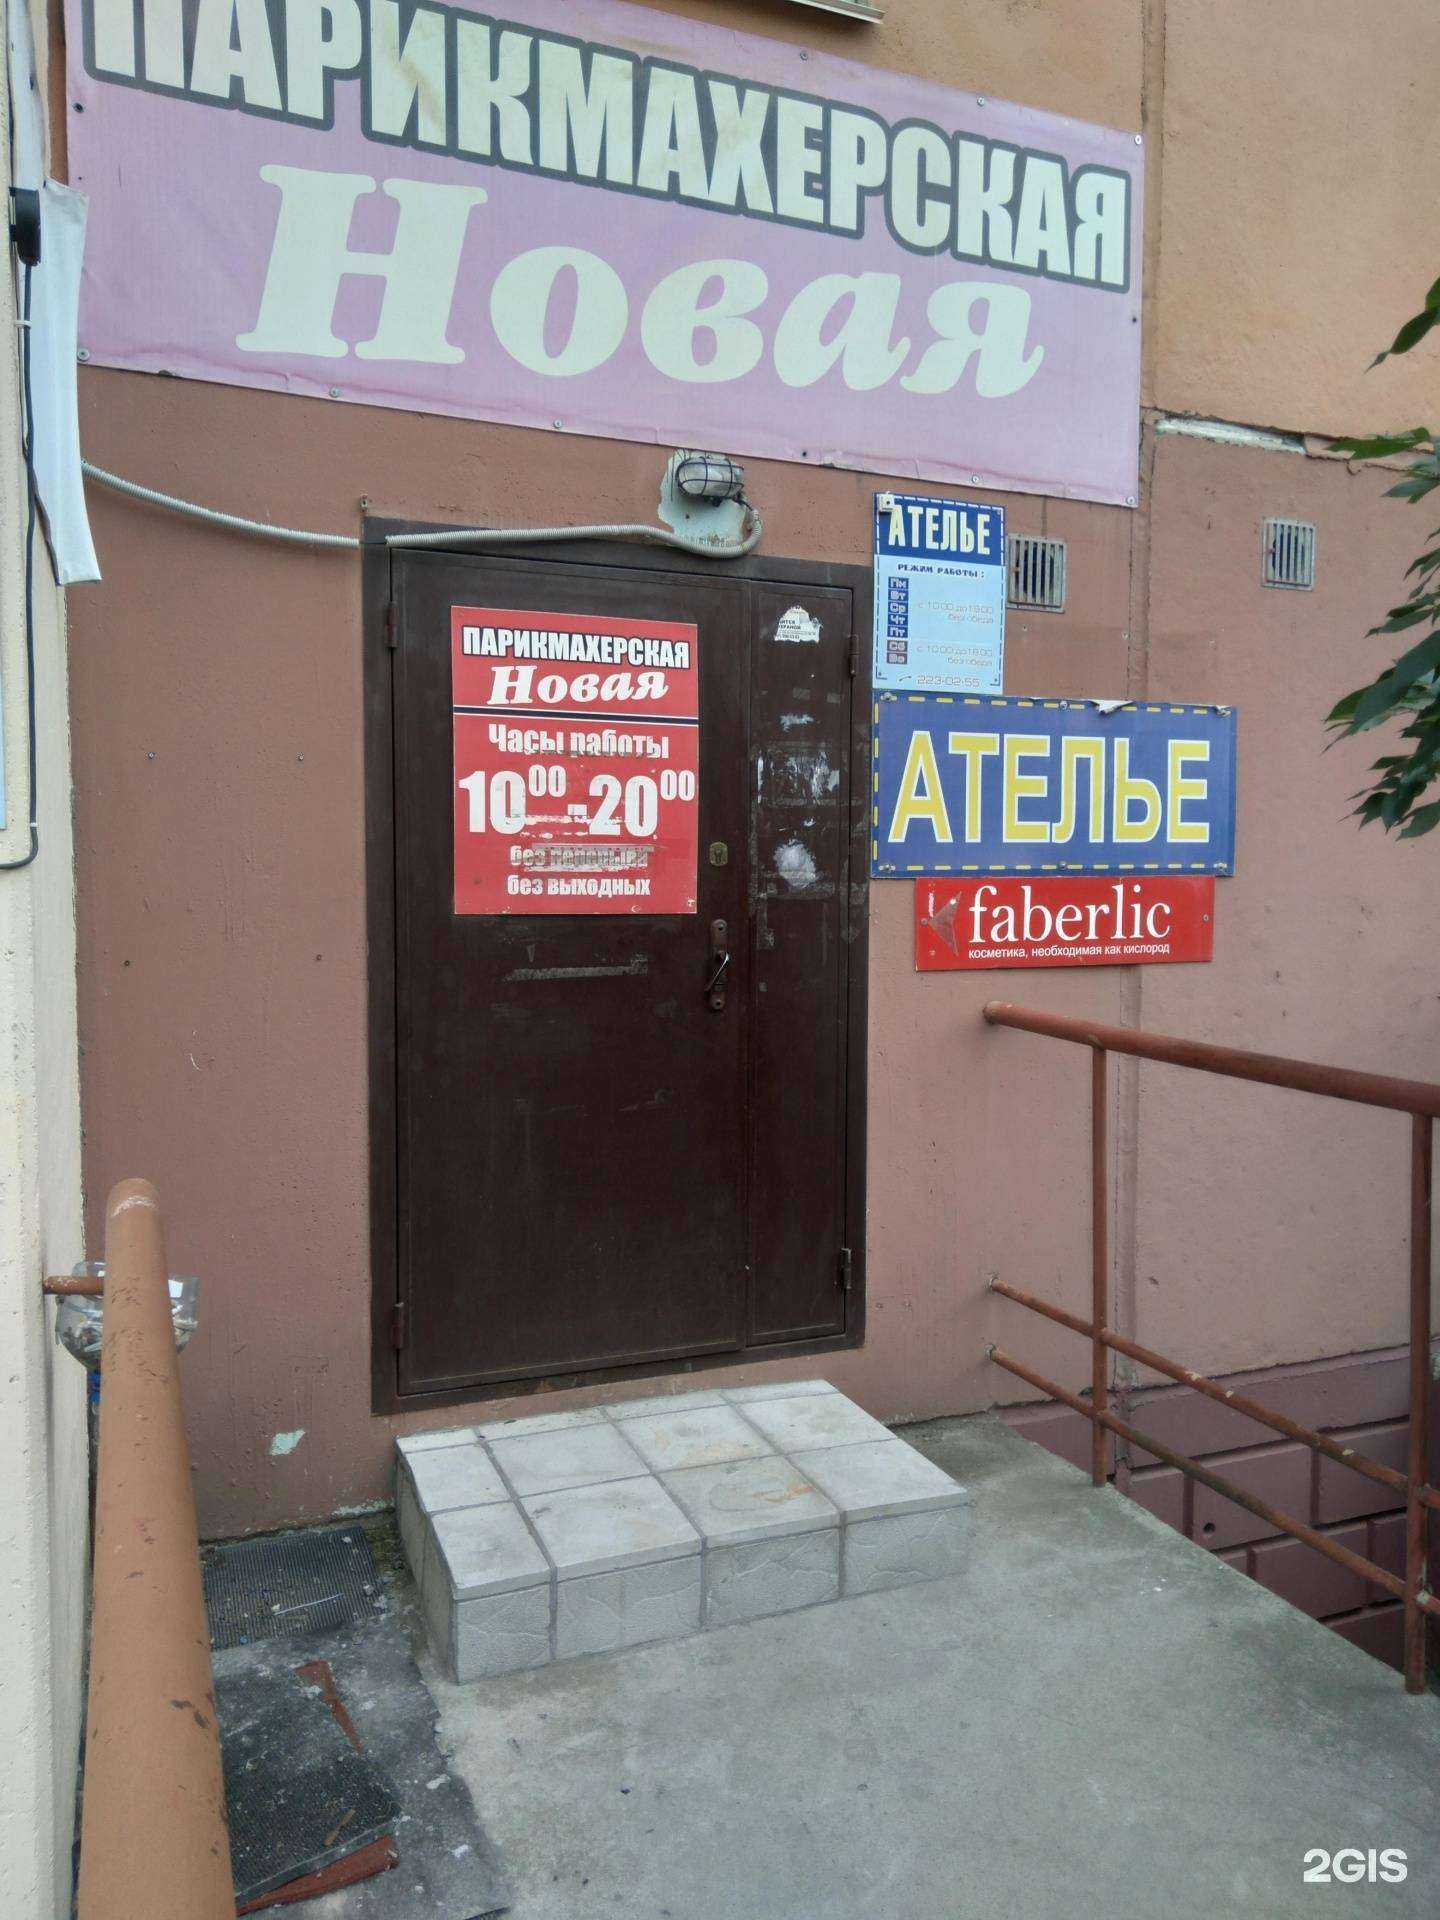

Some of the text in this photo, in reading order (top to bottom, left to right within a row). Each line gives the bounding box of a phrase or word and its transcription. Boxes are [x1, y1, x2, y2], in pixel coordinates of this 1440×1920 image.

[88, 0, 1129, 292] ПАРИКМАХЕРСКАЯ
[235, 164, 1045, 398] Новая
[887, 503, 991, 556] АТЕЛЬЕ
[897, 563, 934, 575] РЕЖИМ
[937, 566, 979, 578] РАБОТЫ
[461, 625, 690, 669] ПАРИКМАХЕРСКАЯ
[486, 665, 669, 705] Новая
[488, 723, 670, 759] Часы работы
[887, 730, 1211, 844] АТЕЛЬЕ
[507, 874, 652, 898] без выходных
[968, 883, 1171, 944] faberlic
[968, 943, 1170, 960] косметика, необходимая как кислород
